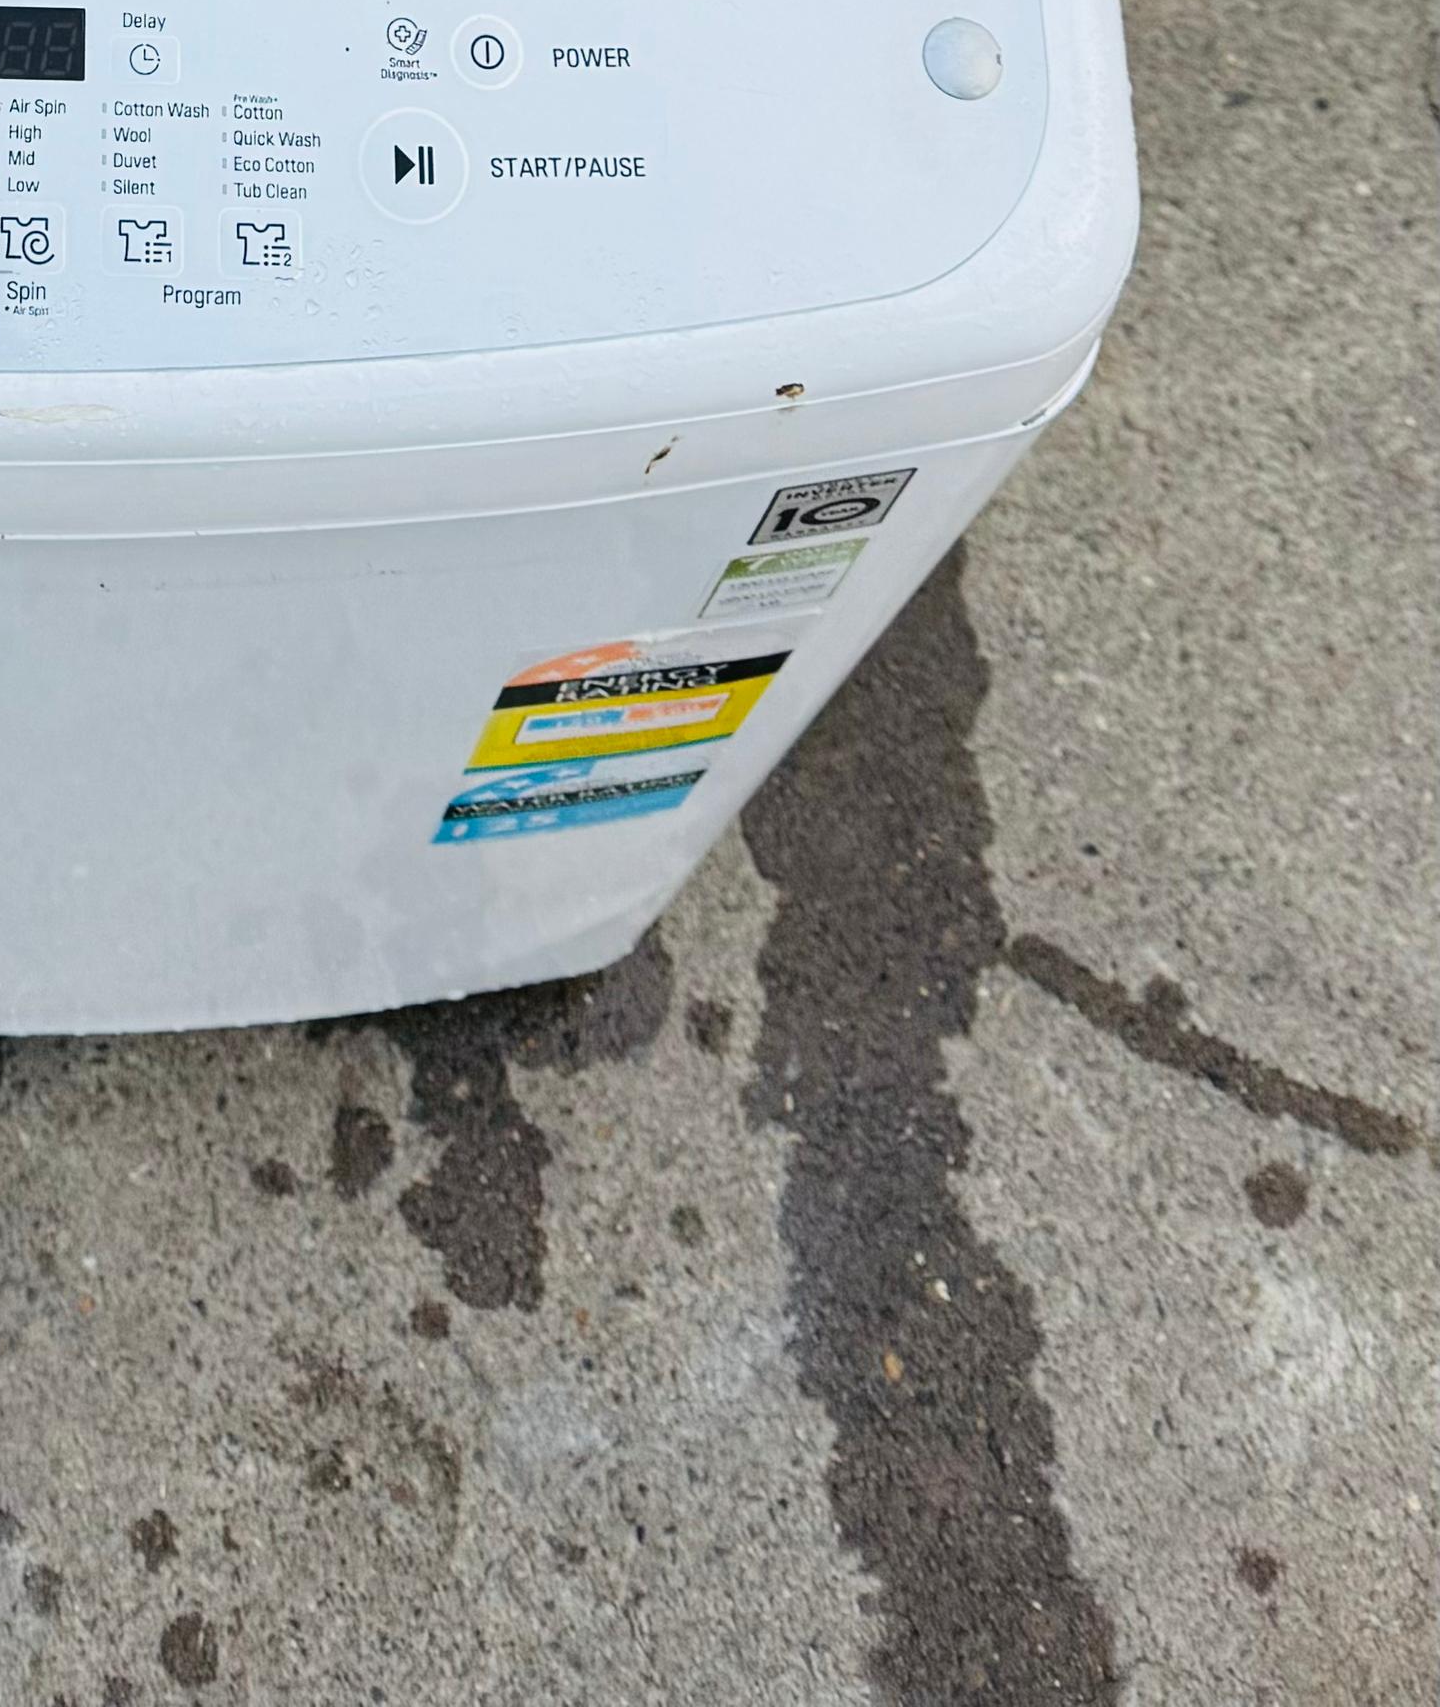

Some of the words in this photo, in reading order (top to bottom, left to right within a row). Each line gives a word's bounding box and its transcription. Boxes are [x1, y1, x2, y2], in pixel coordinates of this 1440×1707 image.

[123, 13, 166, 31] Delay
[388, 57, 420, 70] Smart
[553, 48, 630, 67] POWER
[10, 99, 30, 113] Air
[35, 99, 66, 117] Spin
[115, 101, 163, 116] Cotton
[168, 103, 209, 118] Wash
[234, 104, 282, 120] Cotton
[9, 125, 41, 143] High
[114, 127, 150, 142] Wool
[234, 130, 274, 146] Quick
[279, 132, 320, 147] Wash
[9, 151, 34, 165] Mid
[114, 153, 156, 168] Duvet
[234, 156, 260, 171] Eco
[265, 157, 314, 173] Cotton
[491, 157, 646, 178] START/PAUSE
[8, 177, 39, 192] Low
[114, 179, 155, 195] Silent
[234, 183, 261, 198] Tub
[266, 184, 306, 199] Clean
[7, 281, 45, 304] Spin
[164, 285, 241, 308] Program
